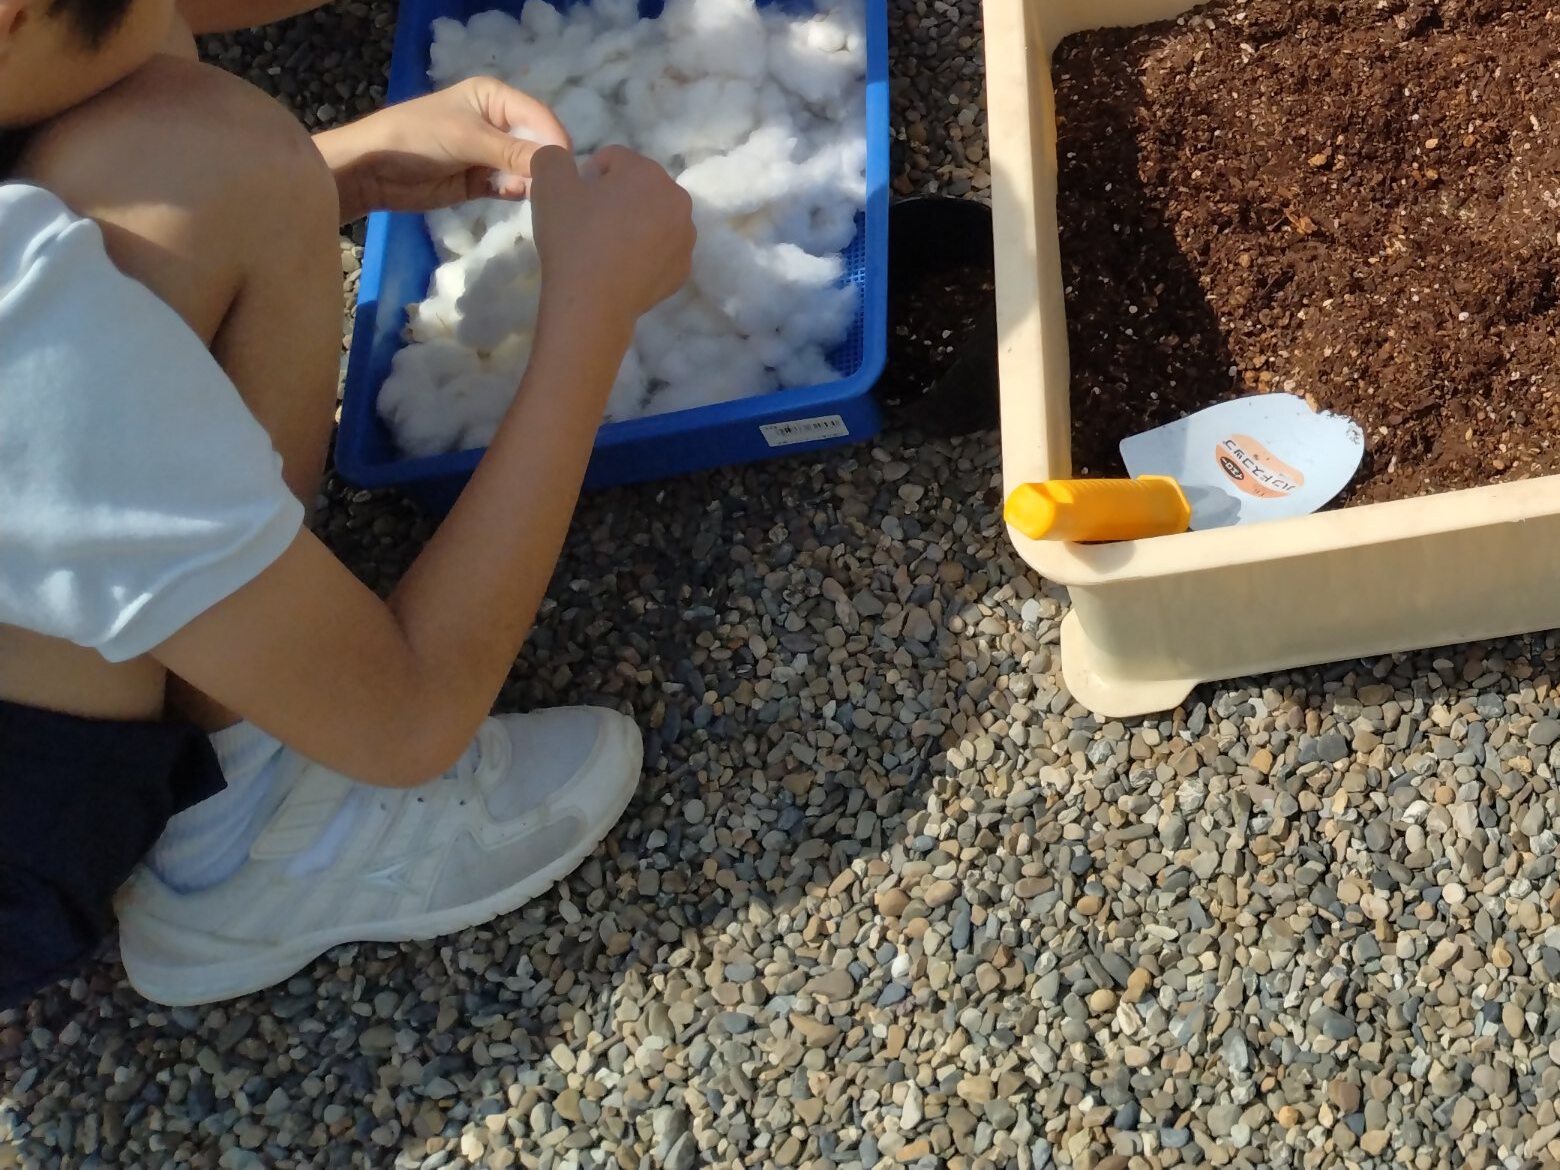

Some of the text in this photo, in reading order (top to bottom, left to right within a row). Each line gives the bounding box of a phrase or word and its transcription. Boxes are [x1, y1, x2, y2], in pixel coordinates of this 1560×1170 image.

[1222, 438, 1297, 492] ハンドスコップ
